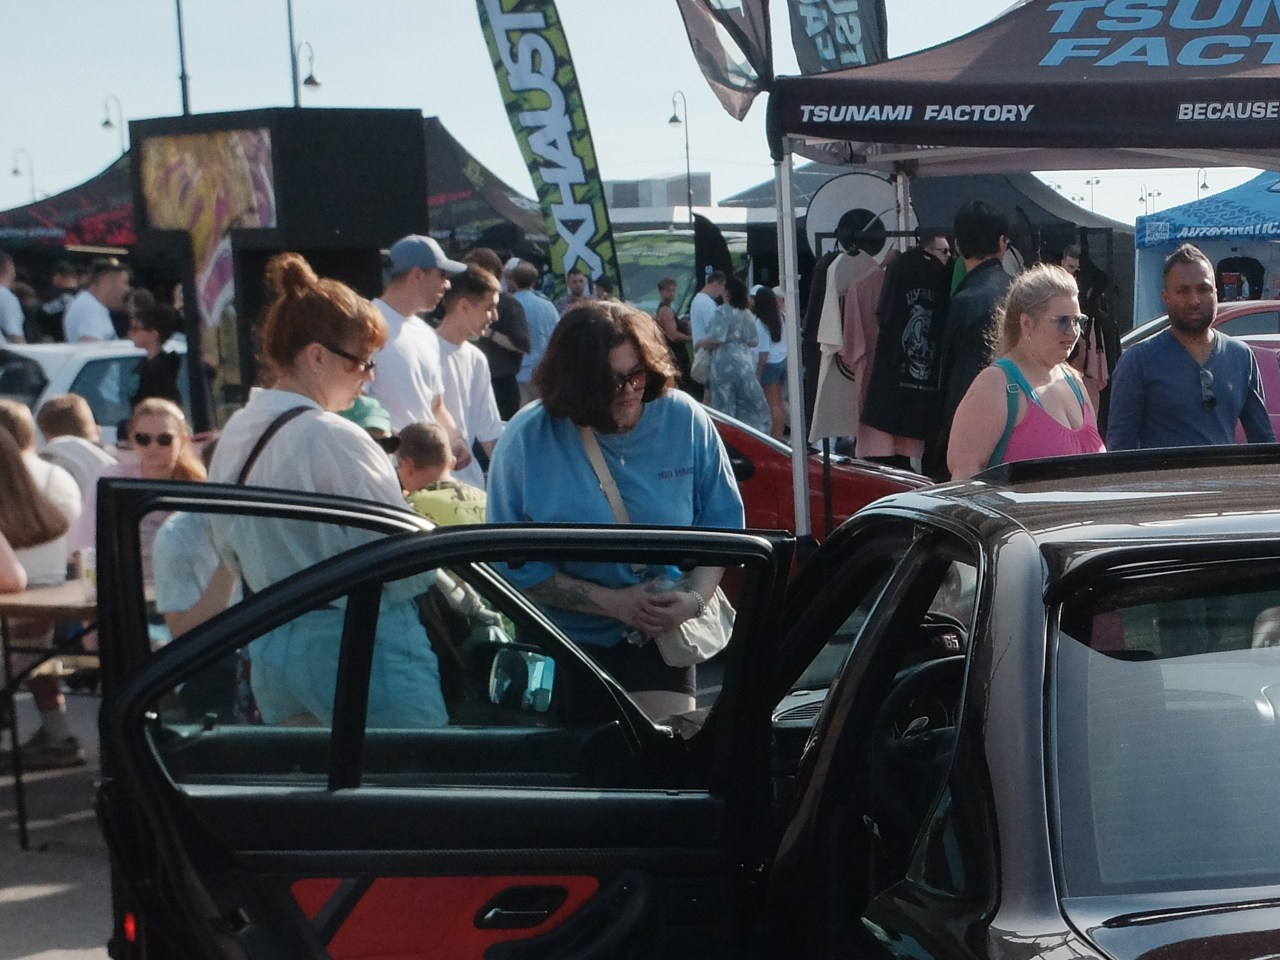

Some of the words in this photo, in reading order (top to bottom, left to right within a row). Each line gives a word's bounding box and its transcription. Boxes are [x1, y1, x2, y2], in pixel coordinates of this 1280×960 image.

[484, 0, 604, 290] XHAUST
[800, 105, 913, 123] TSUNAMI
[924, 104, 1035, 121] FACTORY
[1178, 101, 1280, 120] BECAUSE
